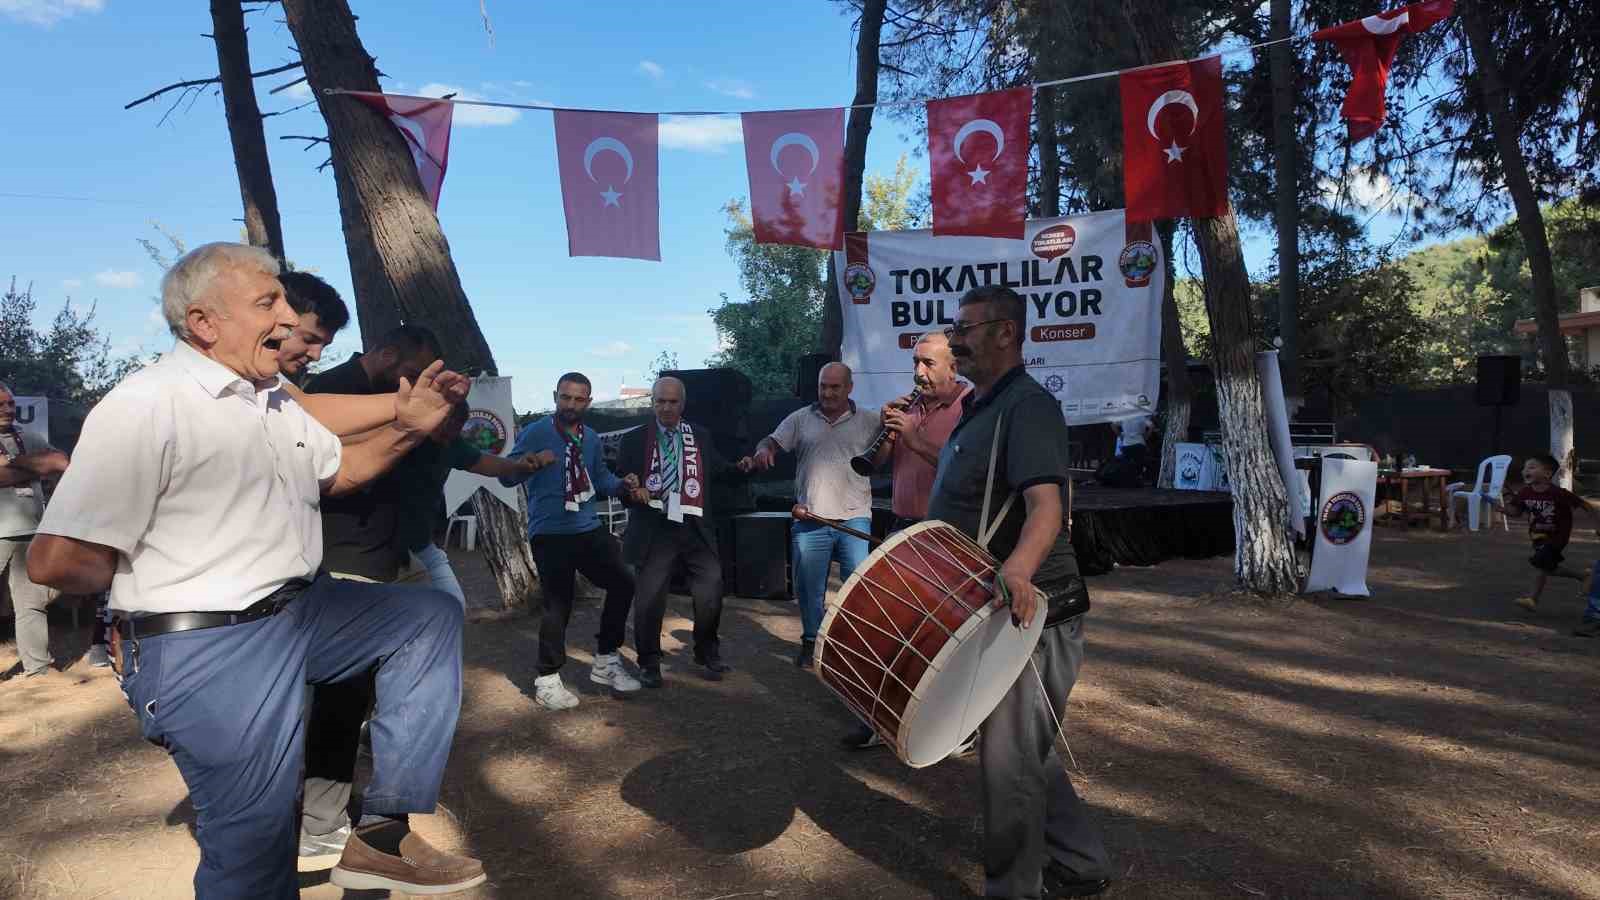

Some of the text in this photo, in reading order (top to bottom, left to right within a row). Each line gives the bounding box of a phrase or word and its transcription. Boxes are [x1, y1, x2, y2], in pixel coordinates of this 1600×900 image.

[889, 255, 1103, 294] TOKATLILAR
[891, 289, 1103, 327] BULYOR
[1040, 328, 1086, 341] Konser
[15, 405, 35, 424] U
